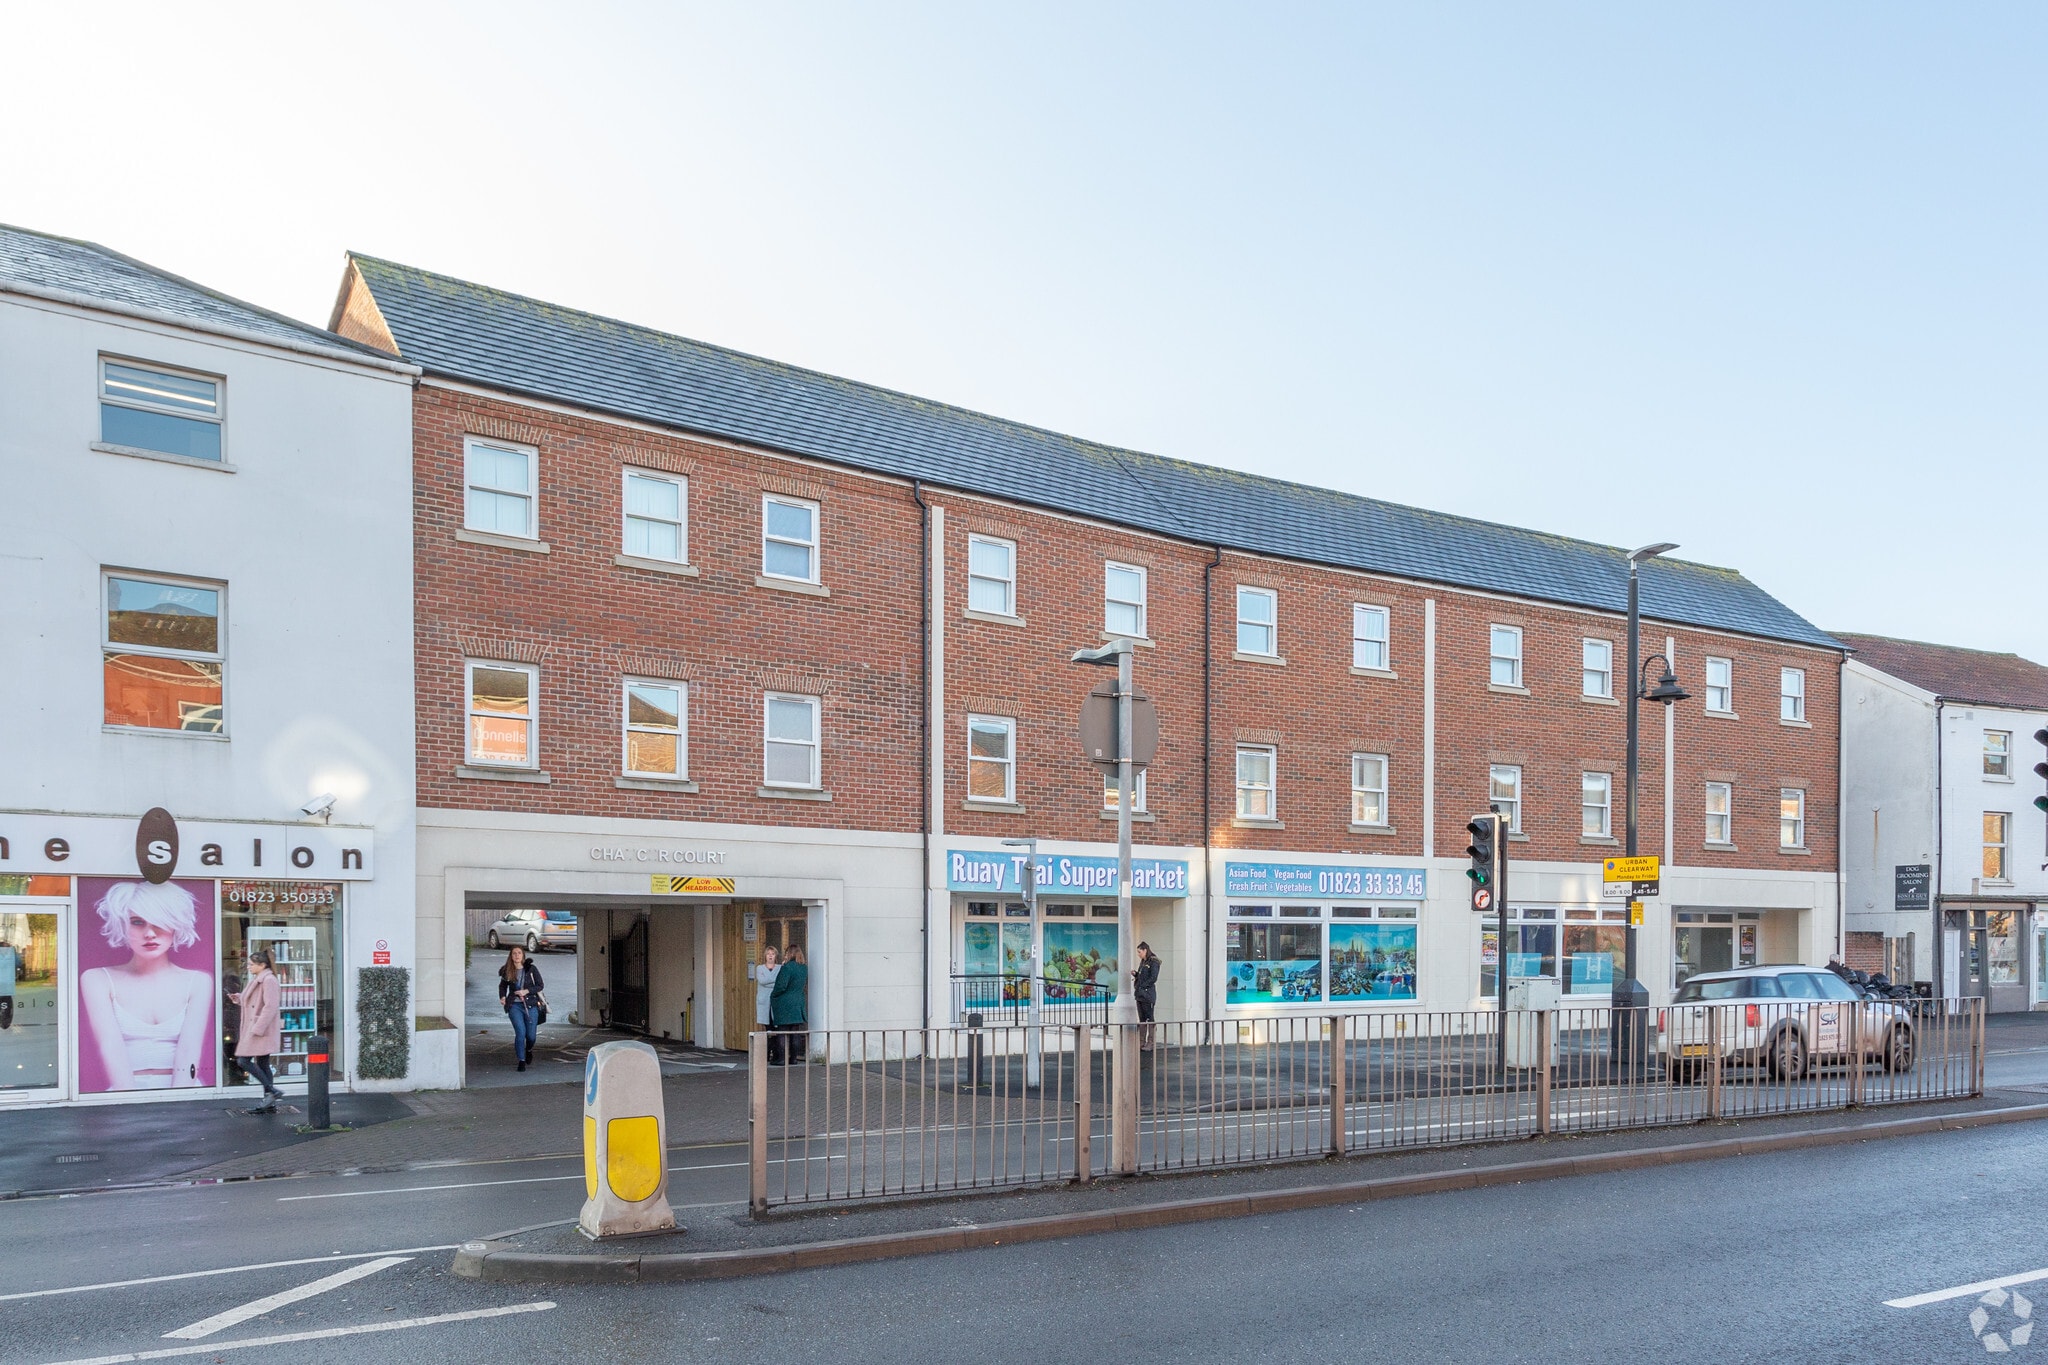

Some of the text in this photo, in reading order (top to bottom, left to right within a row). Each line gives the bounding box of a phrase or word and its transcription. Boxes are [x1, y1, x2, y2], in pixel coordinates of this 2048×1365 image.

[473, 727, 526, 743] Connells
[147, 838, 363, 870] salon
[673, 850, 727, 864] COURT
[952, 853, 1185, 892] Ruay Tai Superarket
[1229, 868, 1312, 880] Asian Food Vegan Food
[1229, 881, 1249, 891] Fresh
[1250, 881, 1268, 892] Fruit
[1275, 882, 1312, 893] Vegetables
[1319, 871, 1423, 895] 01823 33 33 45
[229, 891, 335, 904] 01823 350333
